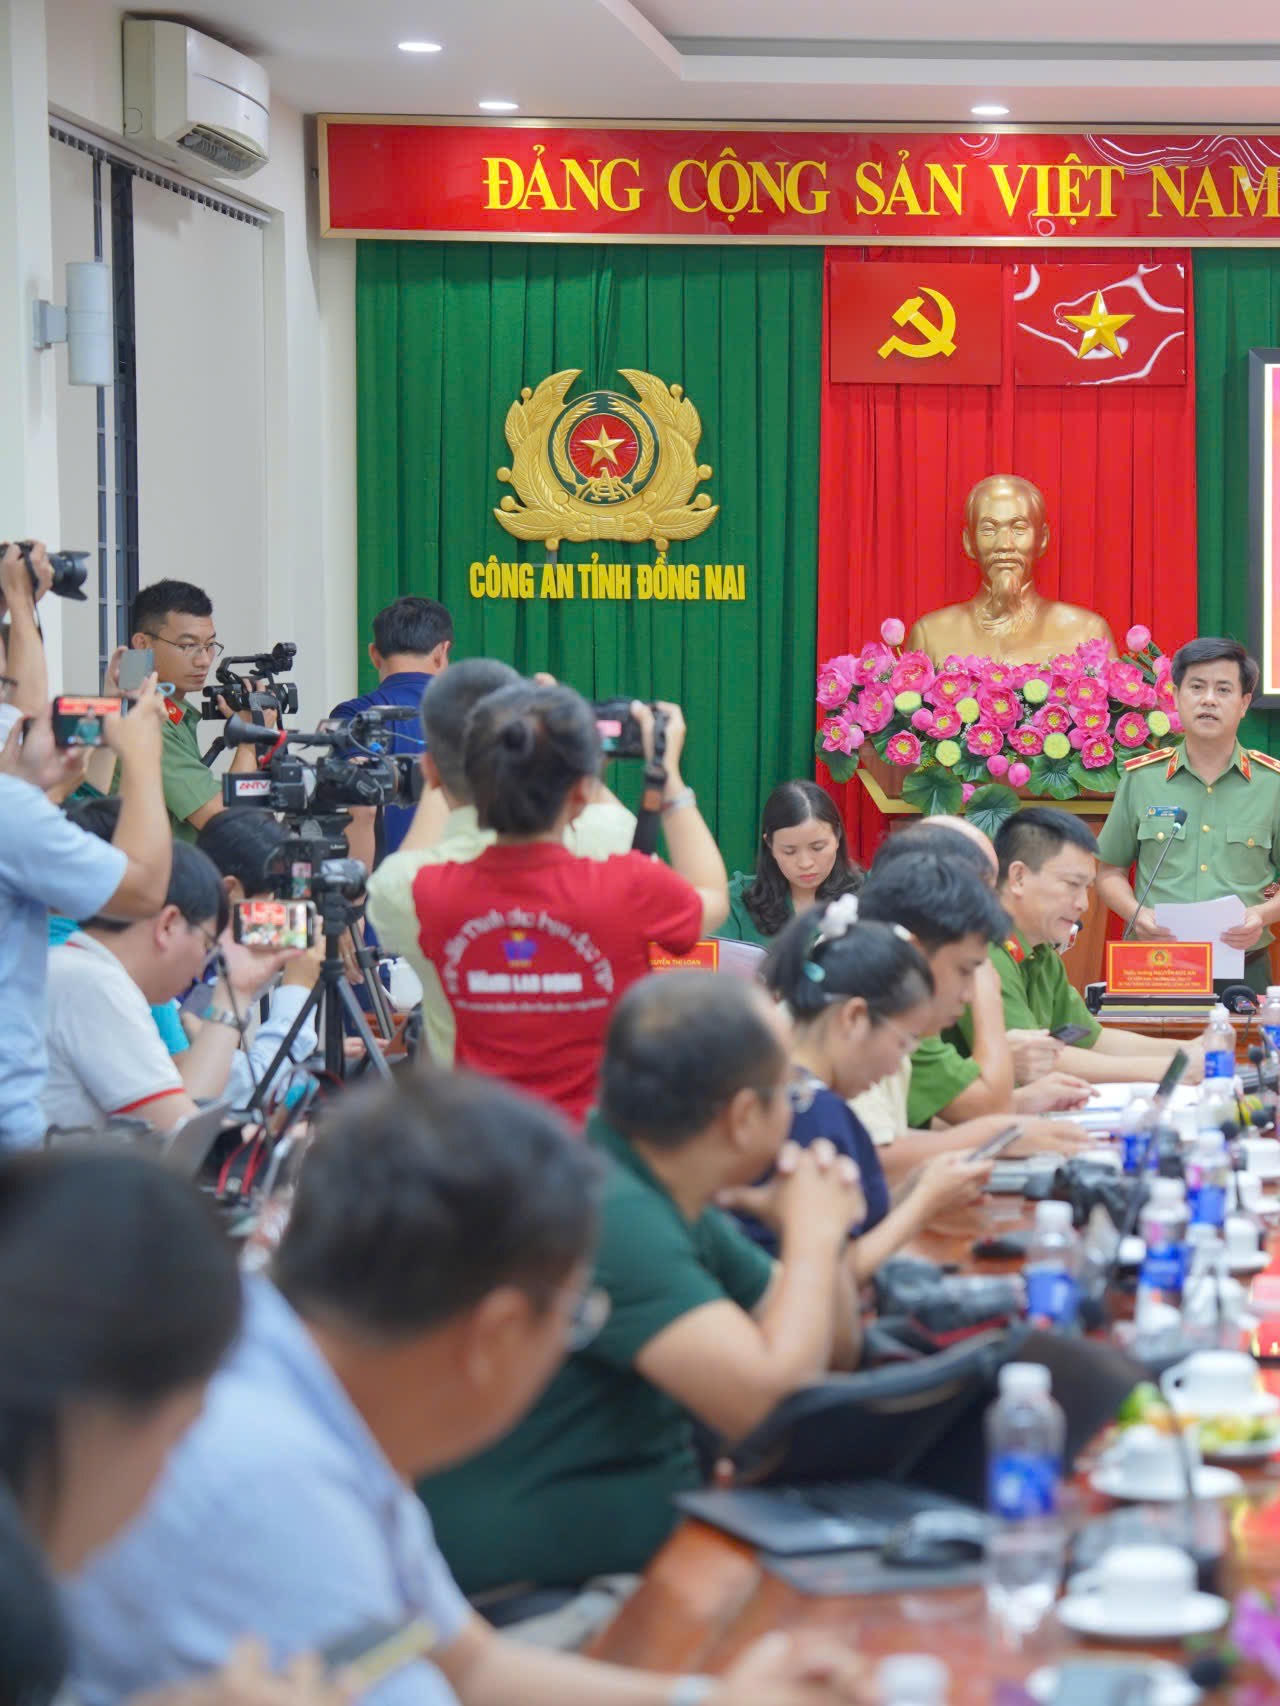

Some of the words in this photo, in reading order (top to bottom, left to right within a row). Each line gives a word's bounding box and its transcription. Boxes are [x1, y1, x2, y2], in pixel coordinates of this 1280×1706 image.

[482, 144, 644, 212] ĐẢNG
[668, 147, 830, 222] CỘNG
[855, 149, 965, 216] SẢN
[989, 152, 1125, 225] VIỆT
[469, 554, 534, 599] CÔNG
[540, 563, 574, 600] AN
[577, 551, 631, 600] TỈNH
[636, 551, 700, 600] ĐỒNG
[705, 563, 746, 600] NAI
